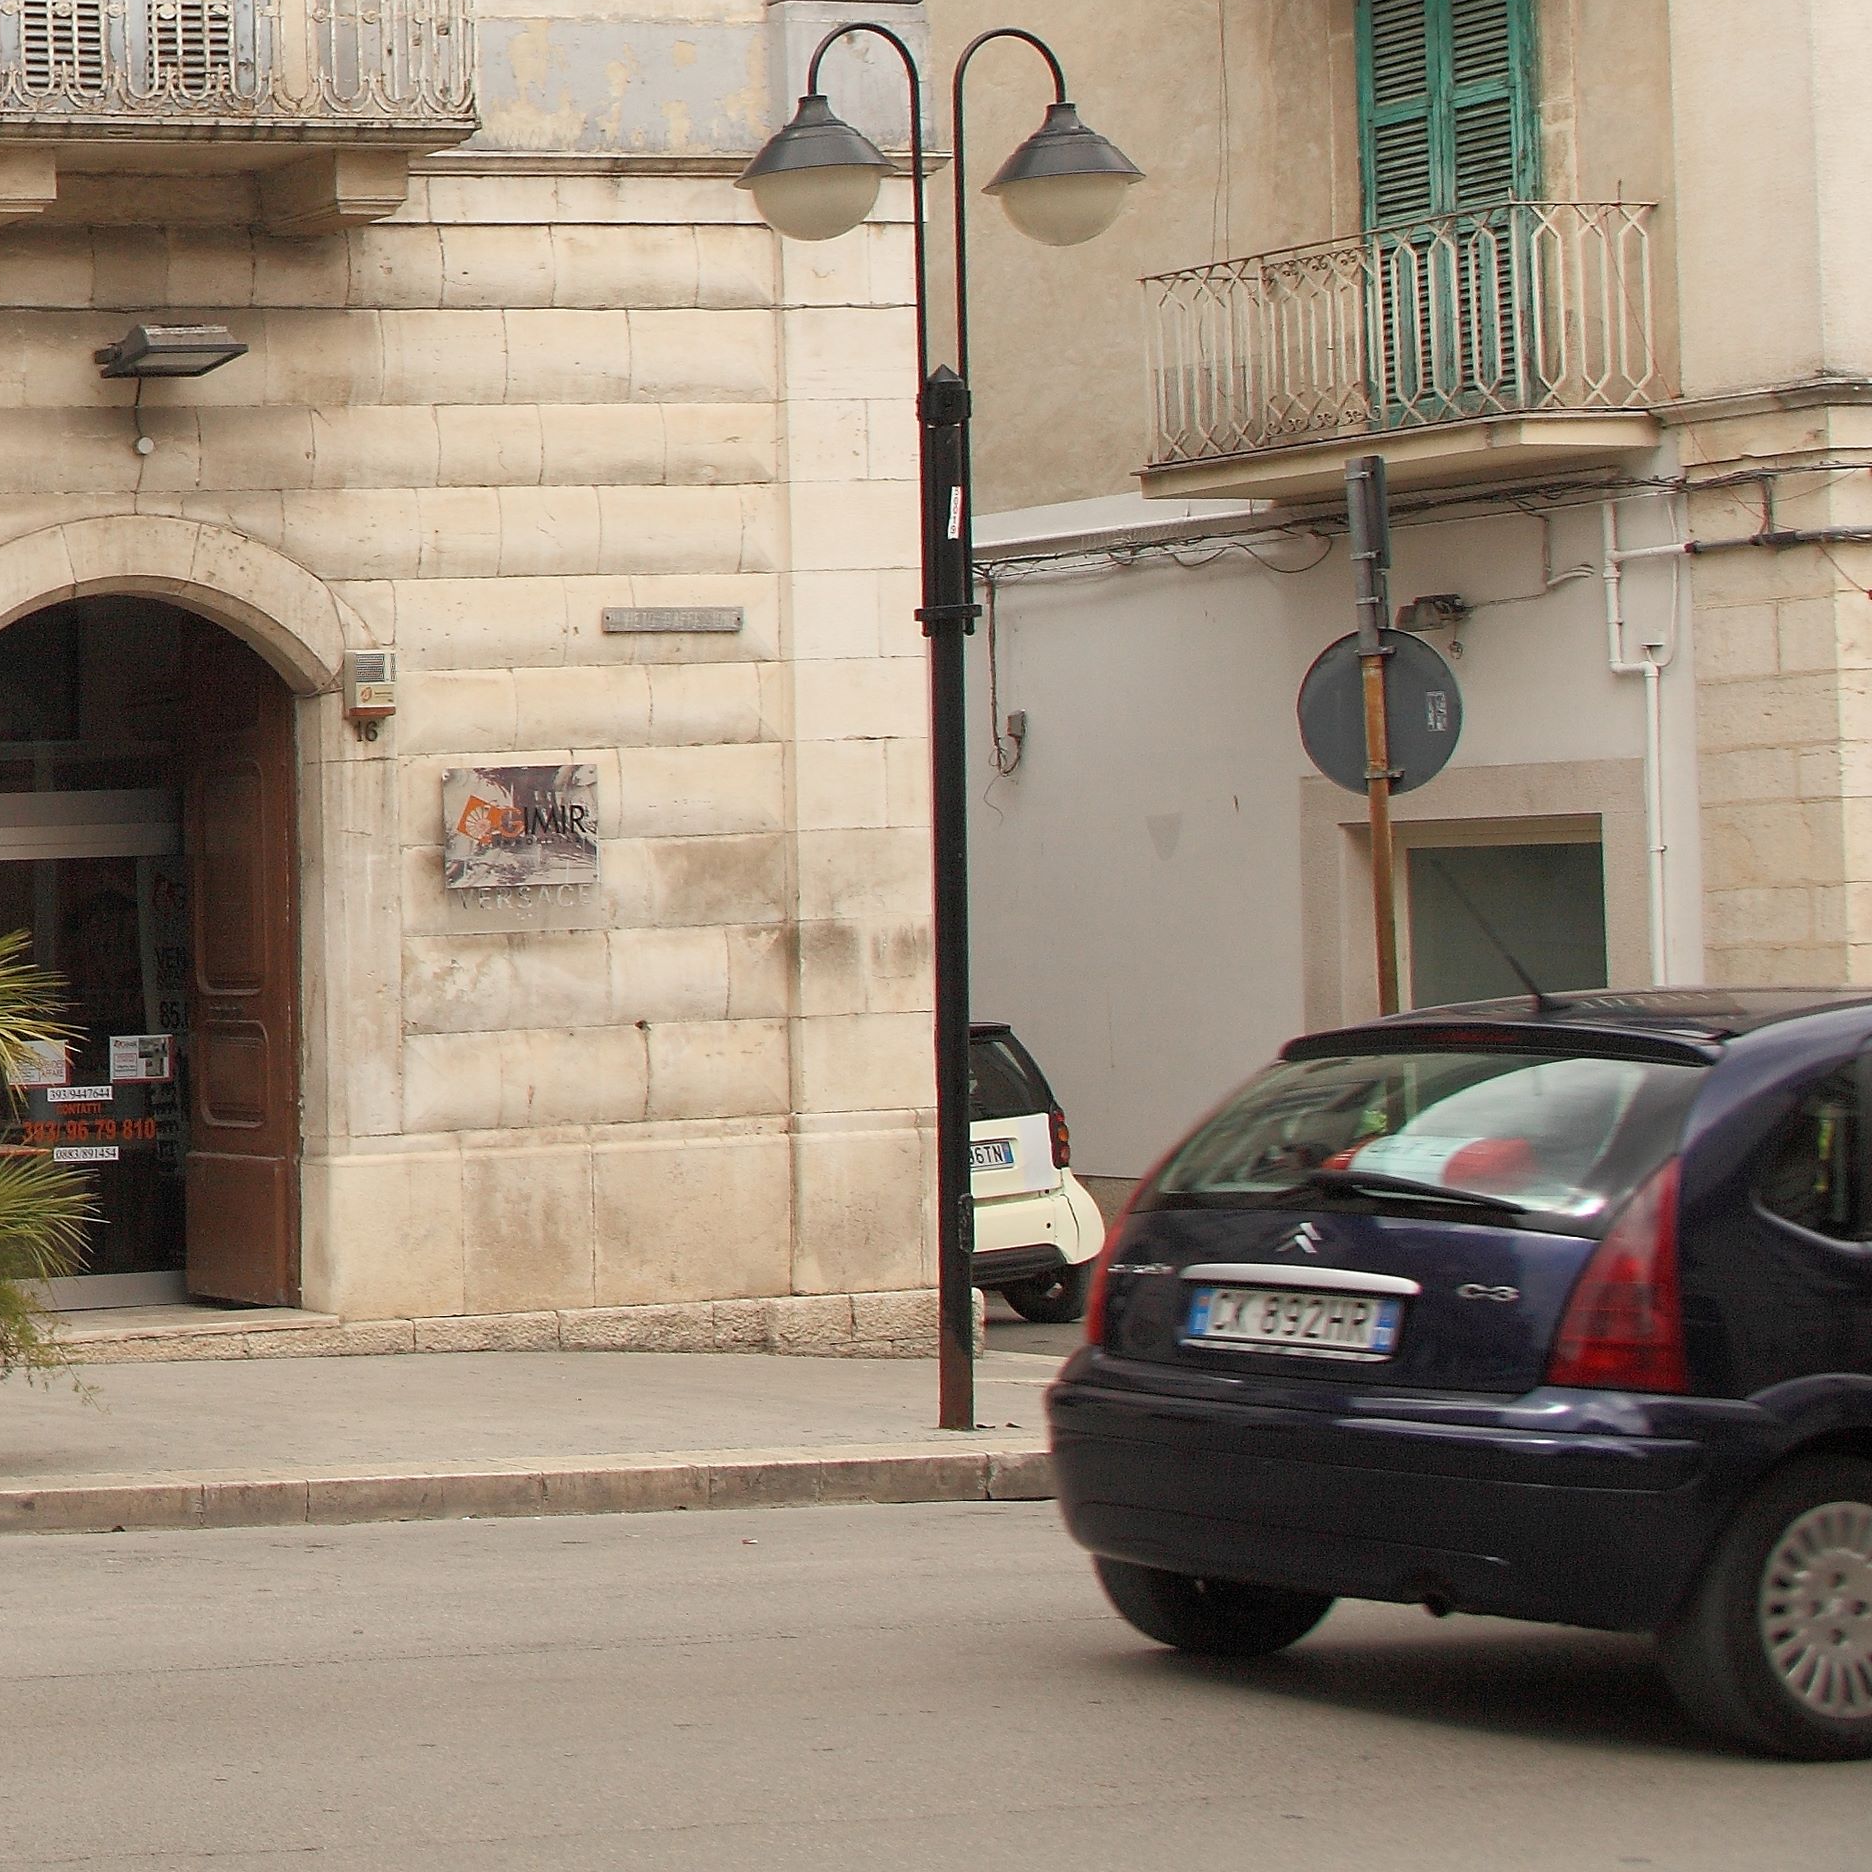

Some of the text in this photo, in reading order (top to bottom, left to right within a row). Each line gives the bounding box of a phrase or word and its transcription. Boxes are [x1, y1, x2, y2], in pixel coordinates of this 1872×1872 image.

[356, 720, 378, 742] 16
[459, 885, 593, 910] VERSACE
[95, 1117, 117, 1140] 79
[122, 1117, 156, 1140] 810
